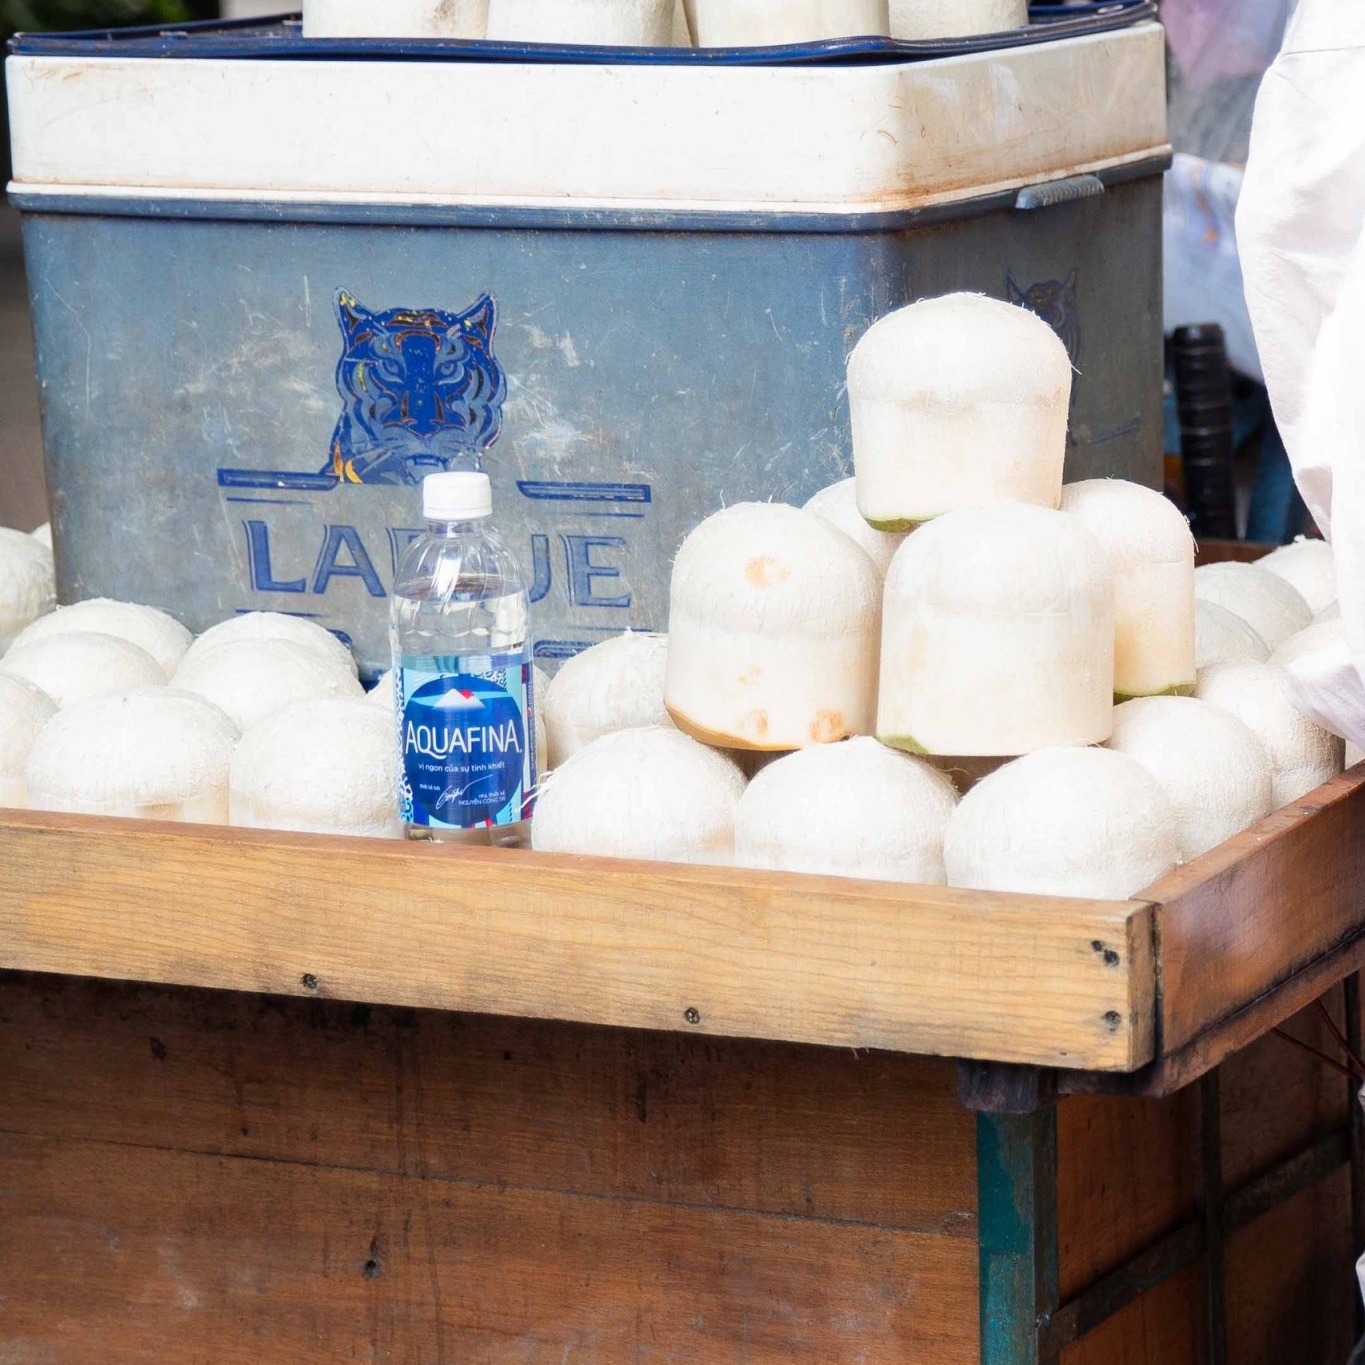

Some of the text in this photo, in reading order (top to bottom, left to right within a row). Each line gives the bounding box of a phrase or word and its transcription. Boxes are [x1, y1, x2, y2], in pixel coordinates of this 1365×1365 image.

[242, 520, 632, 608] LAE
[405, 719, 519, 759] AQUAFINA
[425, 764, 443, 773] ngon
